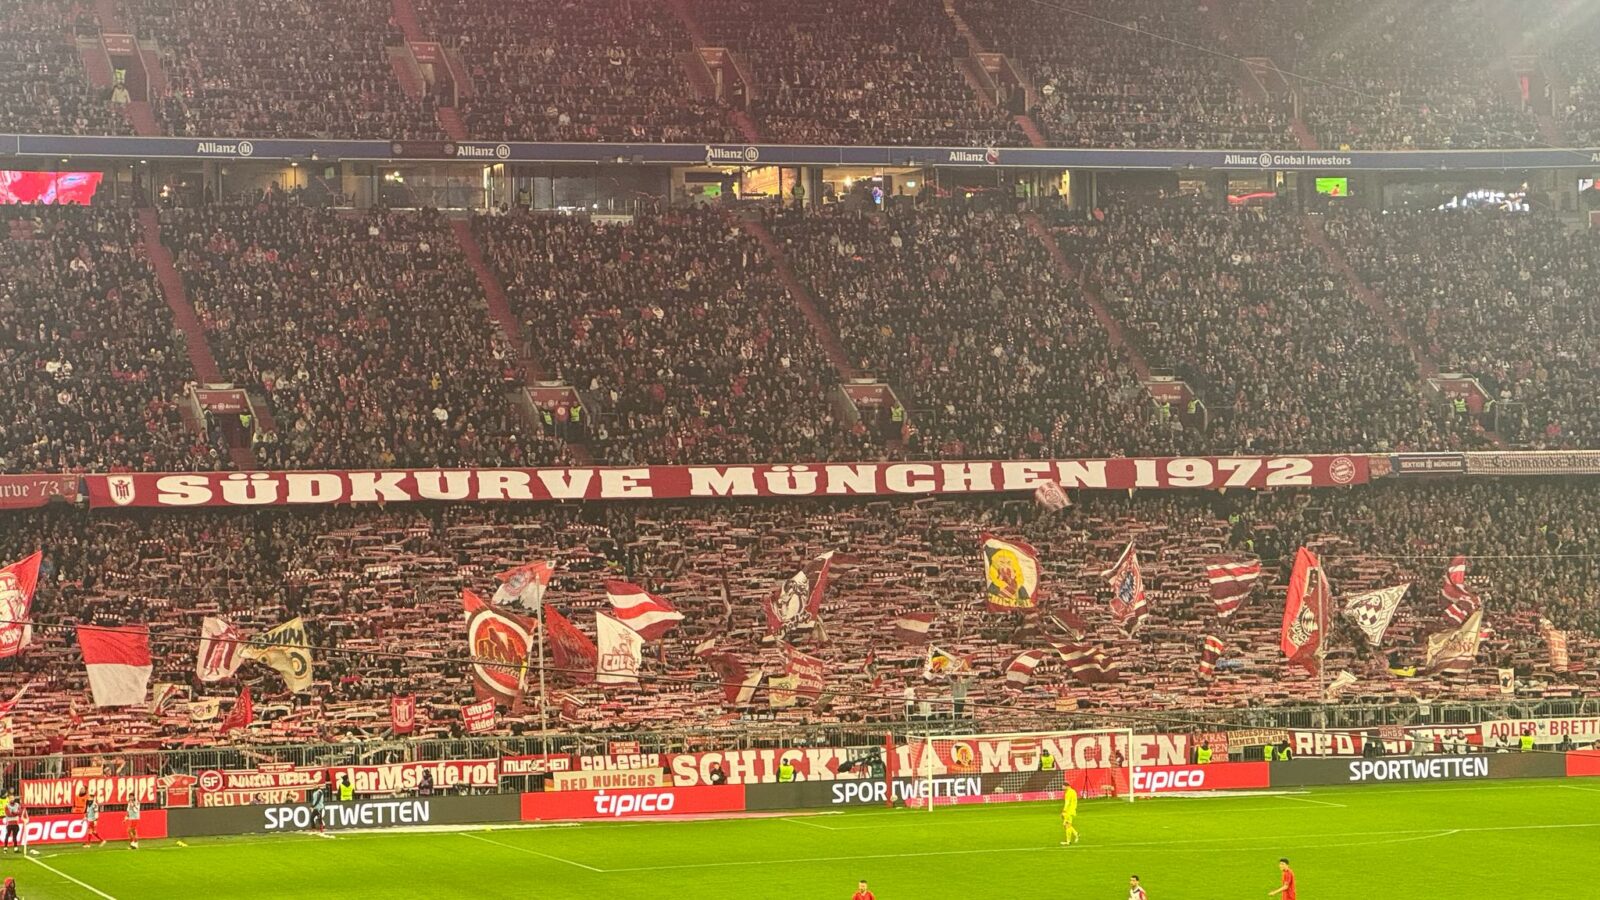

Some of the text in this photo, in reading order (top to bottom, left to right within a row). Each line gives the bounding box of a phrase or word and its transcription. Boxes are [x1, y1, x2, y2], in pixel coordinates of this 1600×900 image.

[197, 142, 236, 154] Allianz
[457, 145, 494, 156] Allianz
[706, 148, 742, 159] Allianz
[949, 151, 984, 162] Allianz
[1224, 154, 1351, 165] Allianz Global Investors
[156, 469, 653, 505] SÜDKURVE
[688, 460, 1107, 496] MÜNCHEN
[1134, 457, 1313, 487] 1972
[1490, 719, 1600, 738] ADLER BRETT
[672, 743, 948, 788] SCHICKIA
[1350, 756, 1488, 782] SPORTWETTEN
[203, 776, 219, 787] SF
[560, 777, 587, 791] RED
[203, 791, 234, 807] RED
[264, 800, 430, 830] SPOTWETTEN
